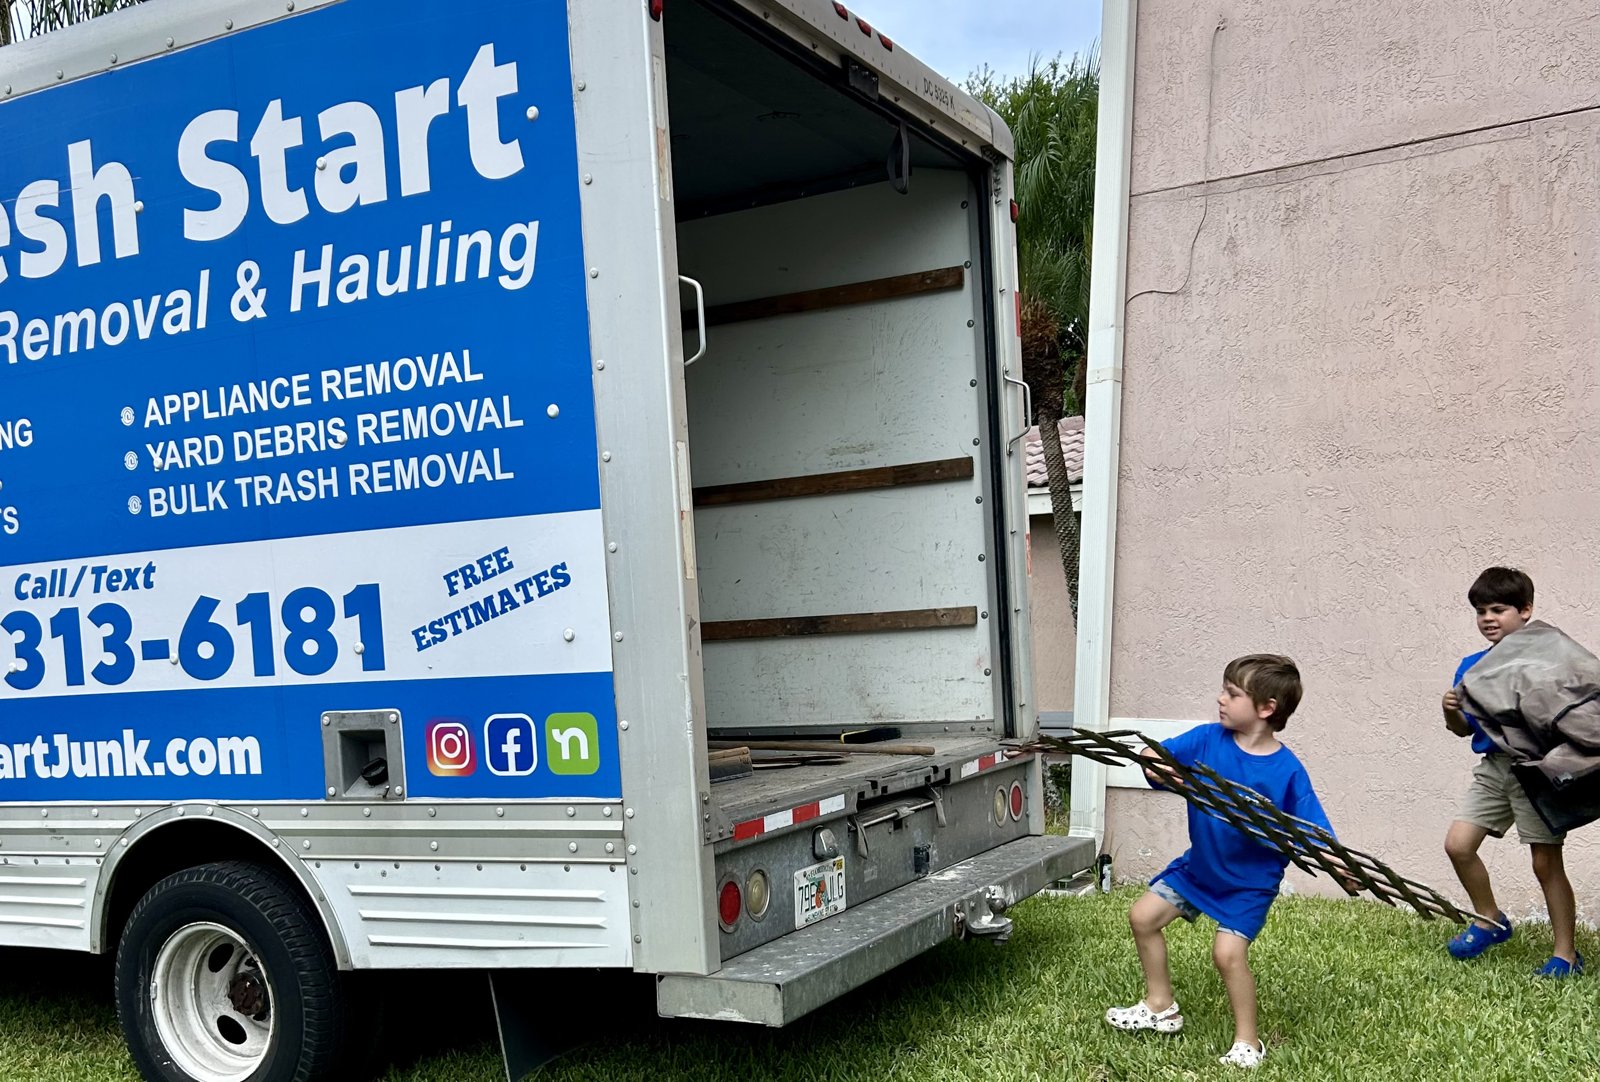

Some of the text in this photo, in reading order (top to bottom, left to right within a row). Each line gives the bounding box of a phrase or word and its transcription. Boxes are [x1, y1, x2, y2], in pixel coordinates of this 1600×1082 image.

[0, 42, 526, 284] sh Start
[0, 219, 540, 364] Removal & Hauling
[144, 373, 311, 428] APPLIANCE
[321, 349, 484, 402] REMOVAL
[146, 395, 524, 472] YARD DEBRIS REMOVAL
[149, 479, 228, 518] BULK
[235, 466, 338, 506] TRASH
[349, 447, 514, 496] REMOVAL
[15, 561, 156, 601] Call/Text
[411, 562, 572, 652] ESTIMATES
[443, 545, 514, 597] FREE
[0, 583, 386, 691] 313-6181
